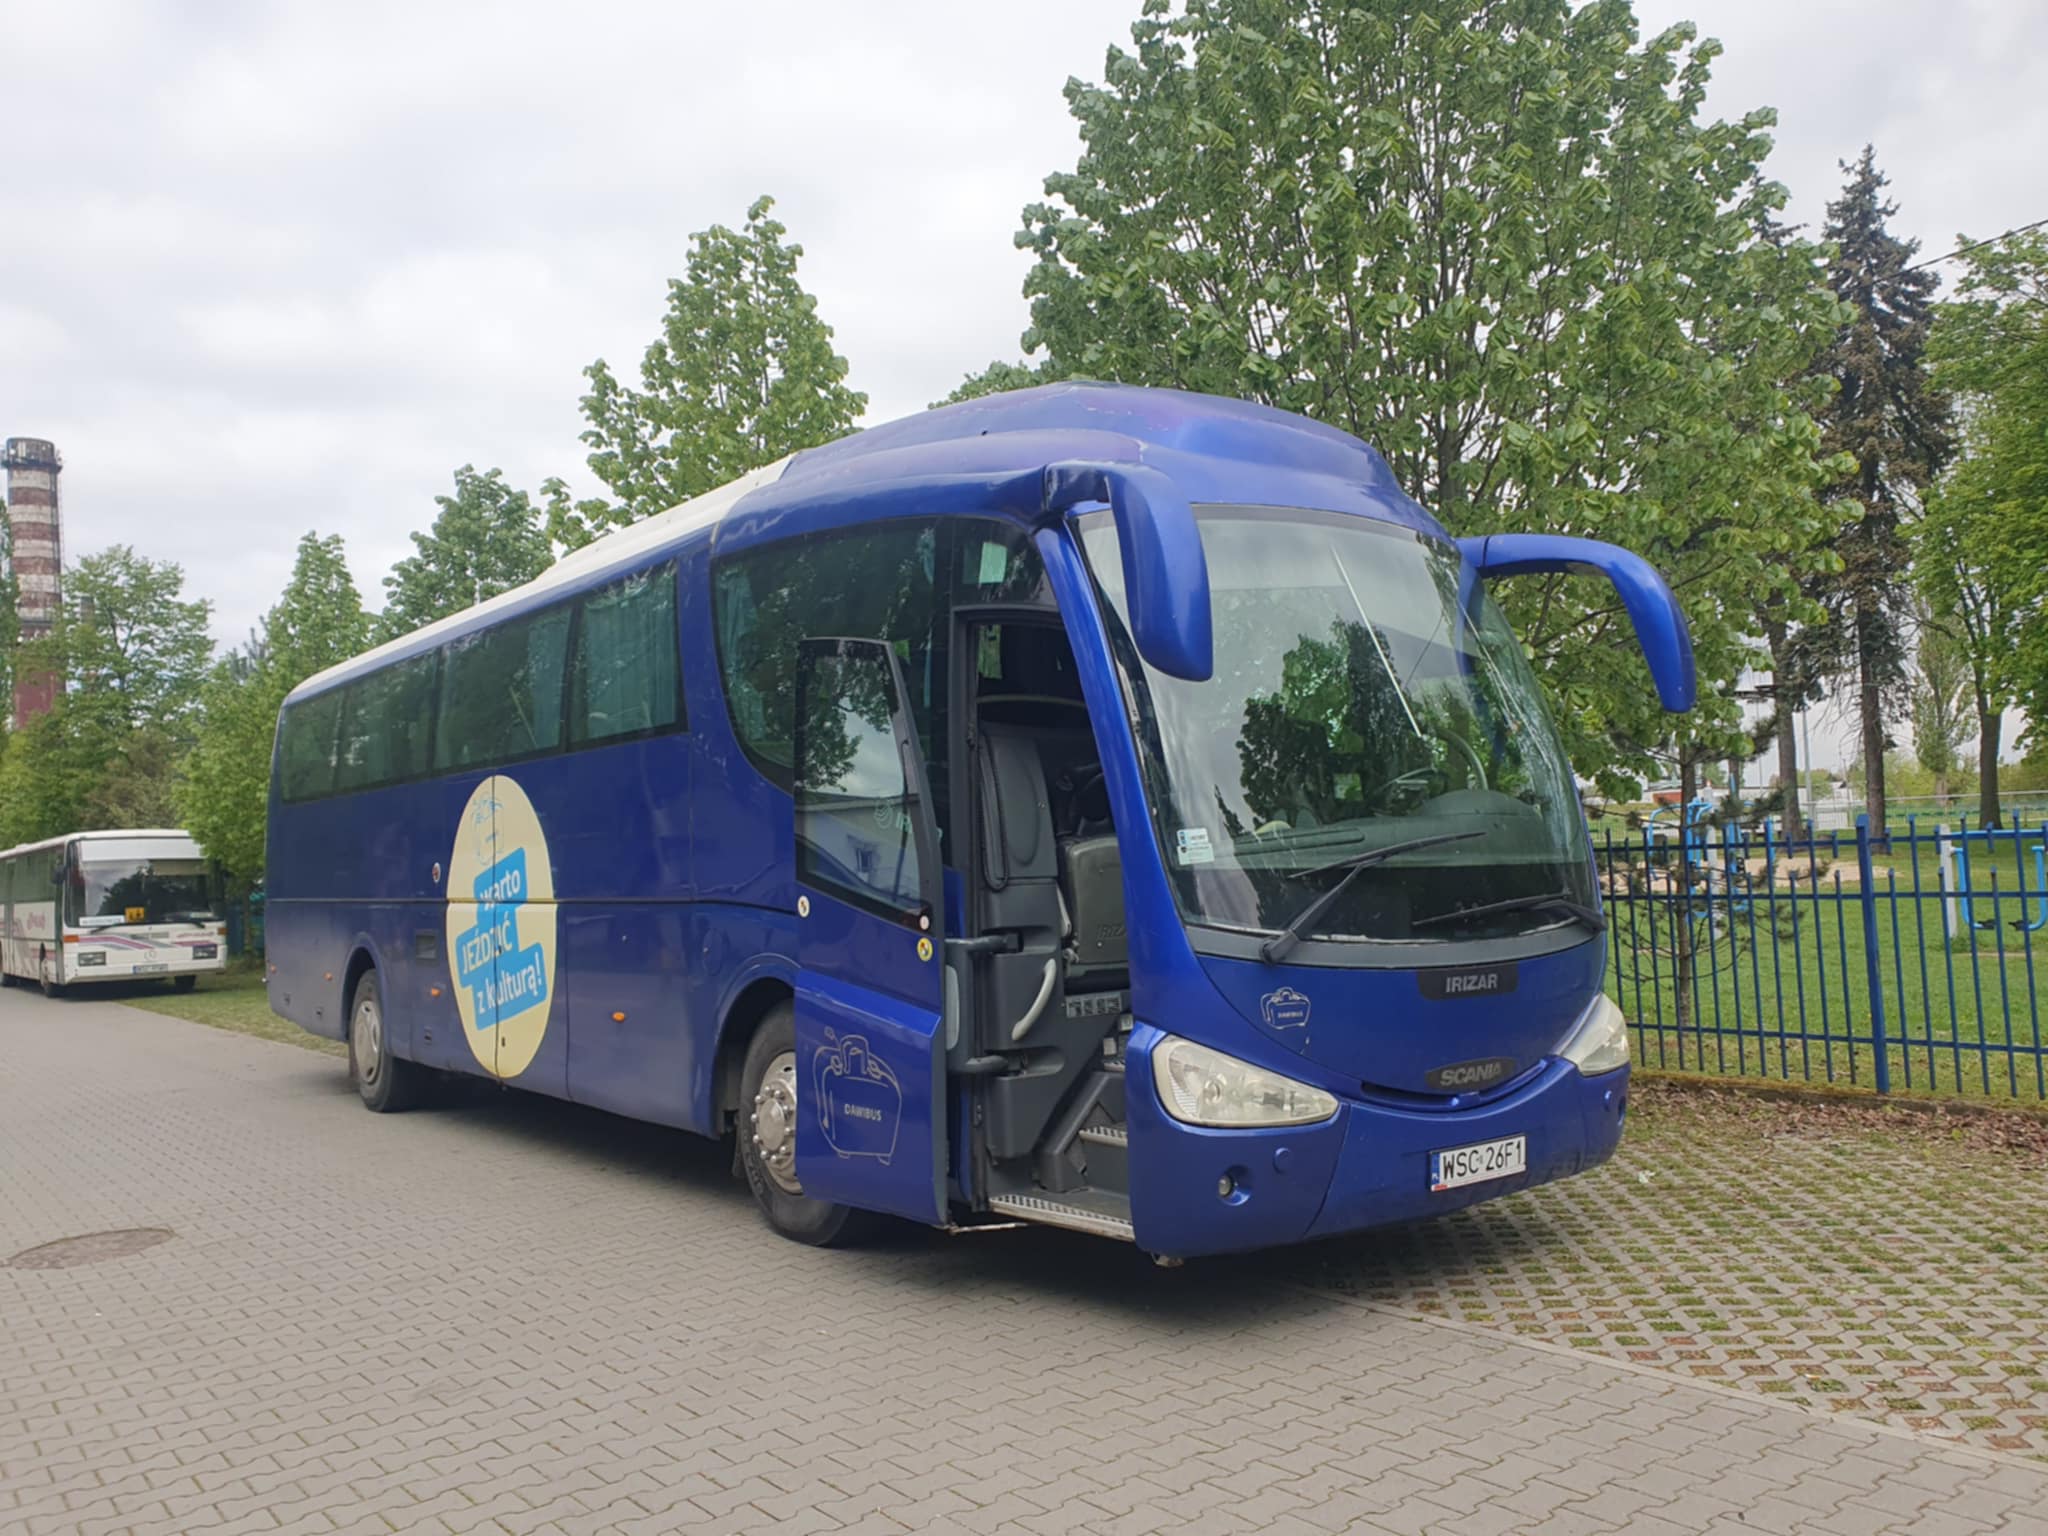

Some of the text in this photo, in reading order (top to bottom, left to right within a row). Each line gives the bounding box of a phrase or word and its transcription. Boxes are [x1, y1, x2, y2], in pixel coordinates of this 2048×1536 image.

[480, 869, 521, 912] warto
[462, 910, 513, 975] JEŹDZIĆ
[477, 951, 542, 1015] z kulturą!
[1445, 973, 1498, 993] IRIZAR
[1440, 1062, 1502, 1087] SCANIA
[1443, 1139, 1521, 1181] WSC 26F1
